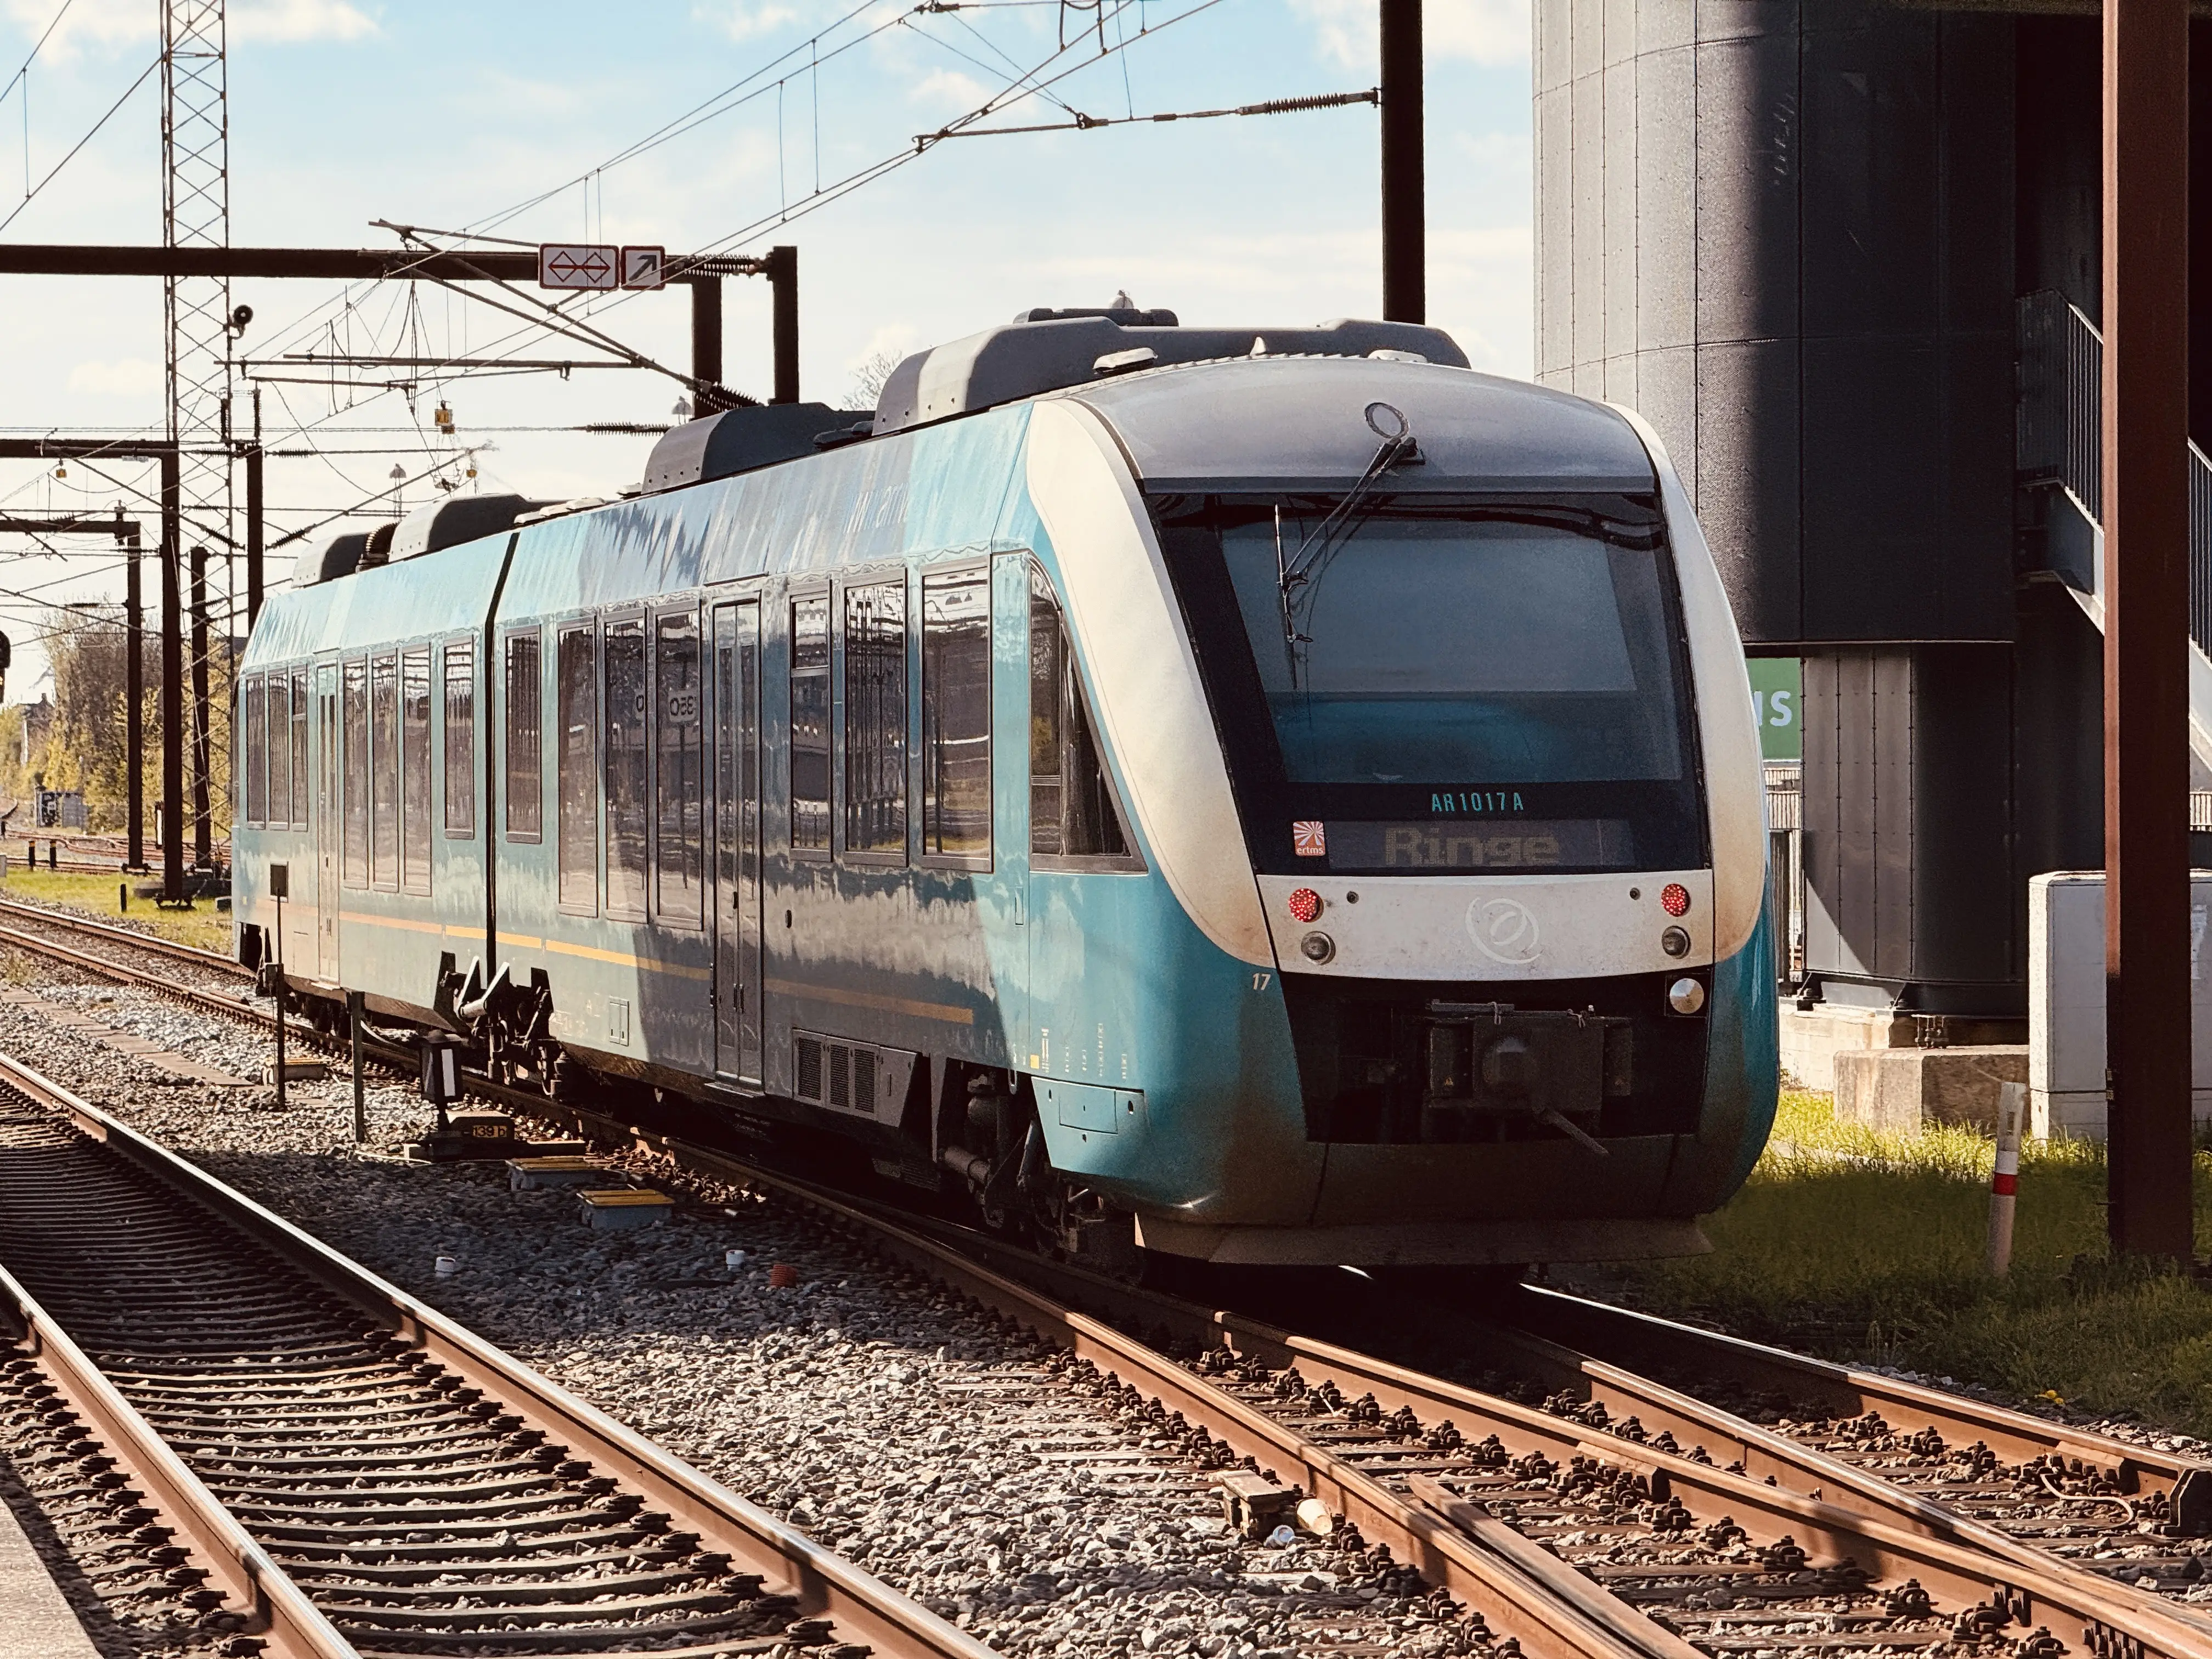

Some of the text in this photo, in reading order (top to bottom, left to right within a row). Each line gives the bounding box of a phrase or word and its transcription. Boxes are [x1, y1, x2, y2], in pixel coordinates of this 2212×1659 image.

[1296, 846, 1324, 855] ertms
[1384, 827, 1560, 867] Ringe
[1252, 973, 1271, 991] 17
